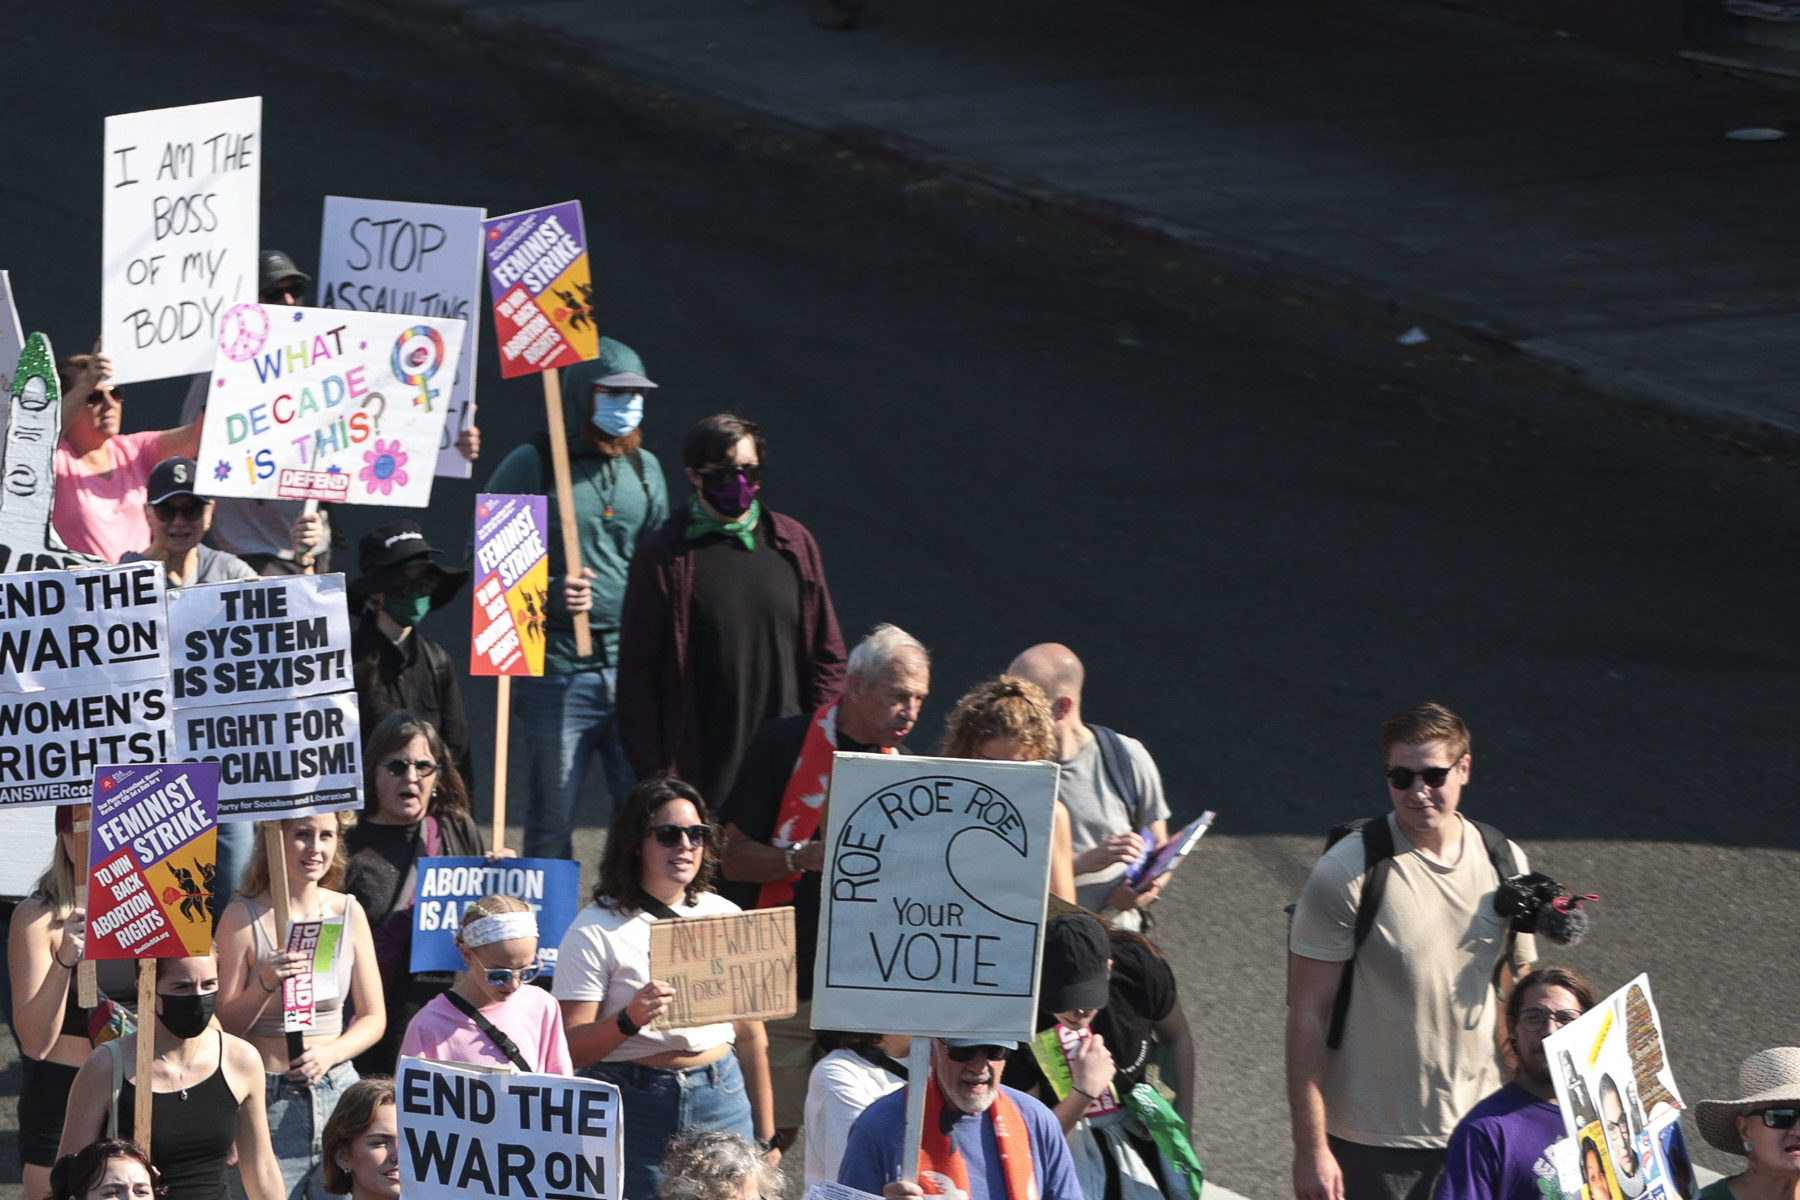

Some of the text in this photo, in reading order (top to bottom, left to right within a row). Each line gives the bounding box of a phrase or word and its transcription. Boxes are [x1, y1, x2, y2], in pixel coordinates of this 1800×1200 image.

[113, 132, 255, 188] I AM THE
[153, 193, 218, 241] BOSS
[126, 248, 227, 289] OF MY
[346, 217, 448, 273] STOP
[492, 214, 567, 290] FEMINIST
[522, 232, 584, 294] STRIKE
[253, 325, 347, 384] WHAT
[226, 365, 369, 444] DECADE
[173, 464, 188, 483] S
[477, 504, 537, 575] FEMINIST
[498, 529, 547, 587] STRIKE
[74, 569, 158, 613] THE
[220, 587, 288, 622] THE
[107, 619, 159, 655] ON
[184, 616, 329, 663] SYSTEM
[173, 649, 347, 699] IS SEXIST!
[187, 706, 344, 751] FIGHT FOR
[97, 774, 196, 852] FEMINIST
[294, 796, 310, 806] and
[133, 800, 213, 864] STRIKE
[832, 781, 1021, 903] ROE ROE ROE
[94, 854, 135, 888] TO WIN
[111, 872, 144, 902] BACK
[421, 867, 545, 900] ABORTION
[91, 890, 155, 939] ABORTION
[115, 909, 165, 949] RIGHTS
[419, 902, 440, 931] IS
[441, 902, 459, 930] A
[893, 896, 965, 927] YOUR
[669, 911, 788, 965] ANTI-WOMEN
[869, 931, 1002, 987] VOTE
[710, 957, 724, 975] IS
[729, 955, 796, 1015] ENERGY
[403, 1068, 610, 1138] END THE
[404, 1127, 606, 1199] WAR ON
